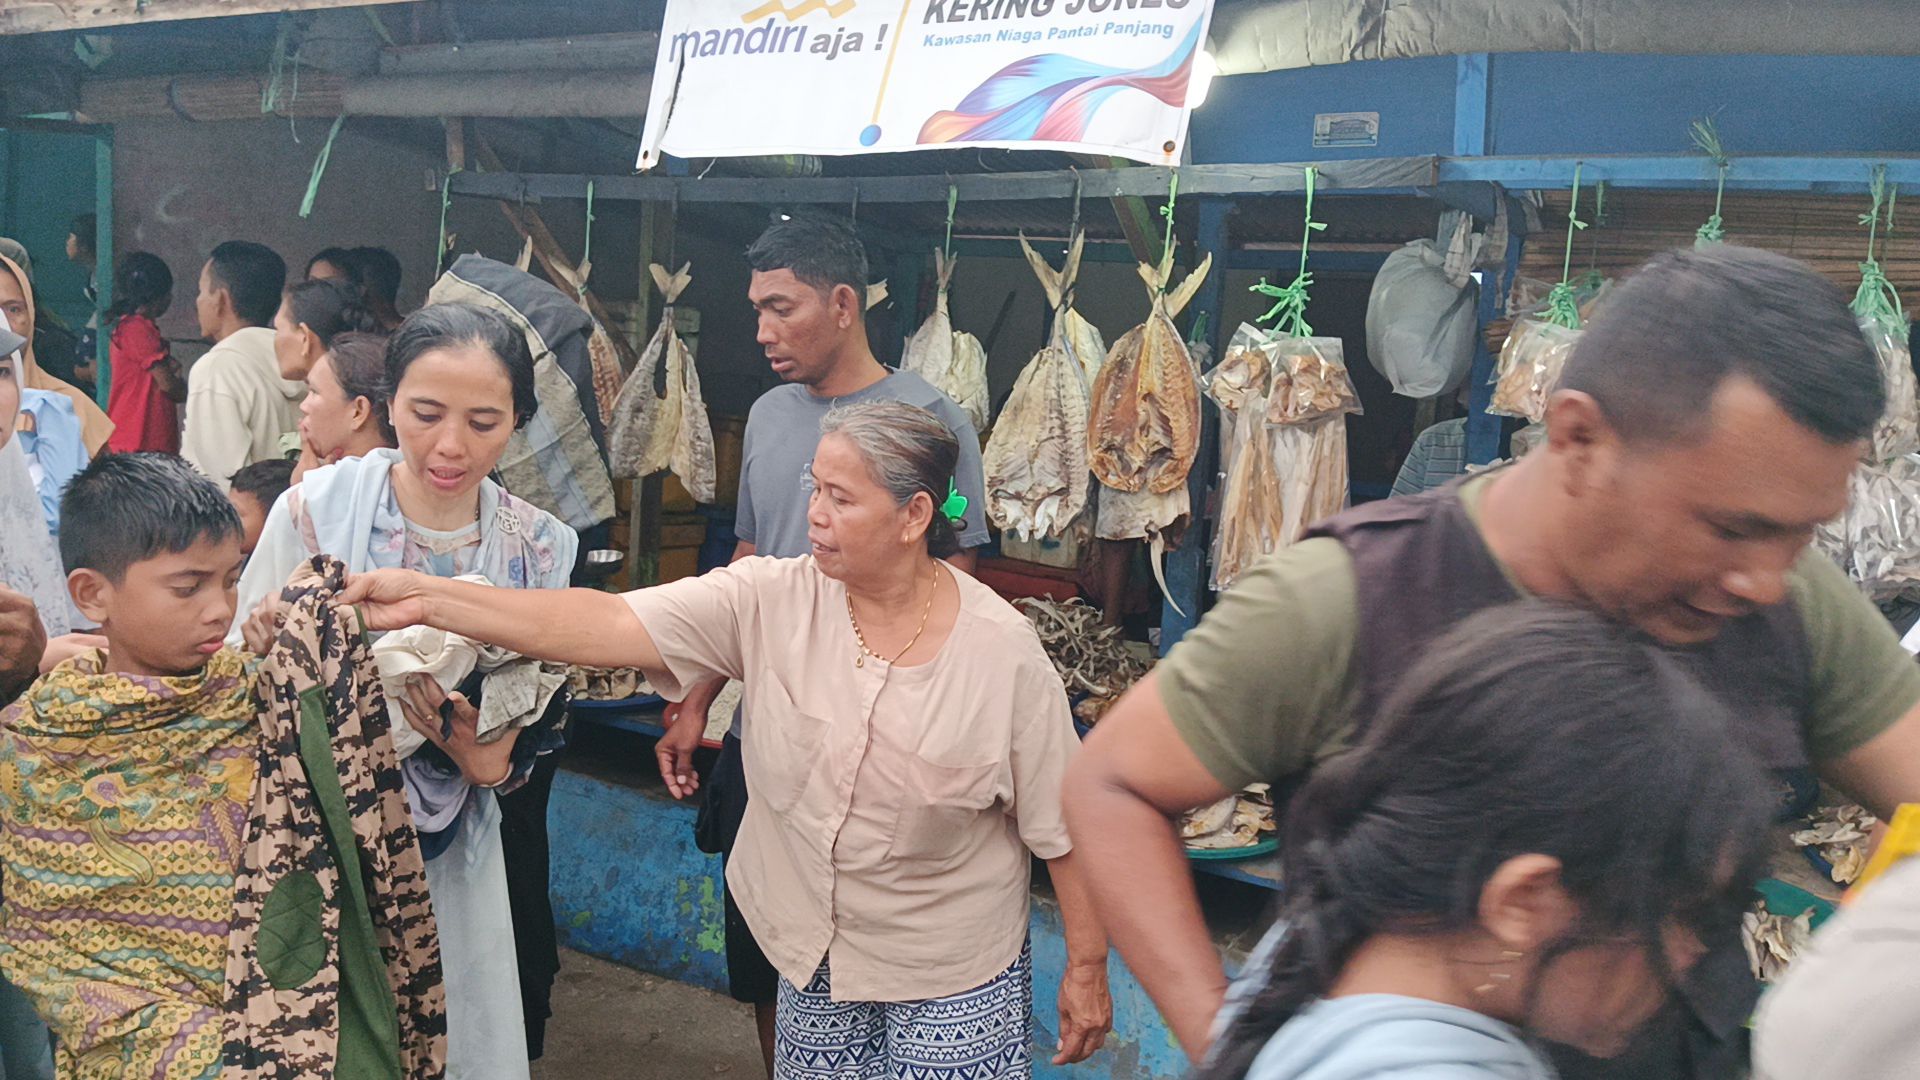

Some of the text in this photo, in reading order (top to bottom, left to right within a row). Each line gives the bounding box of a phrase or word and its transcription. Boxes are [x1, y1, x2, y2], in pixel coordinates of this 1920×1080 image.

[669, 17, 889, 62] mandiri aja !
[923, 20, 1174, 47] Kawasan Niaga Pantai Panjang
